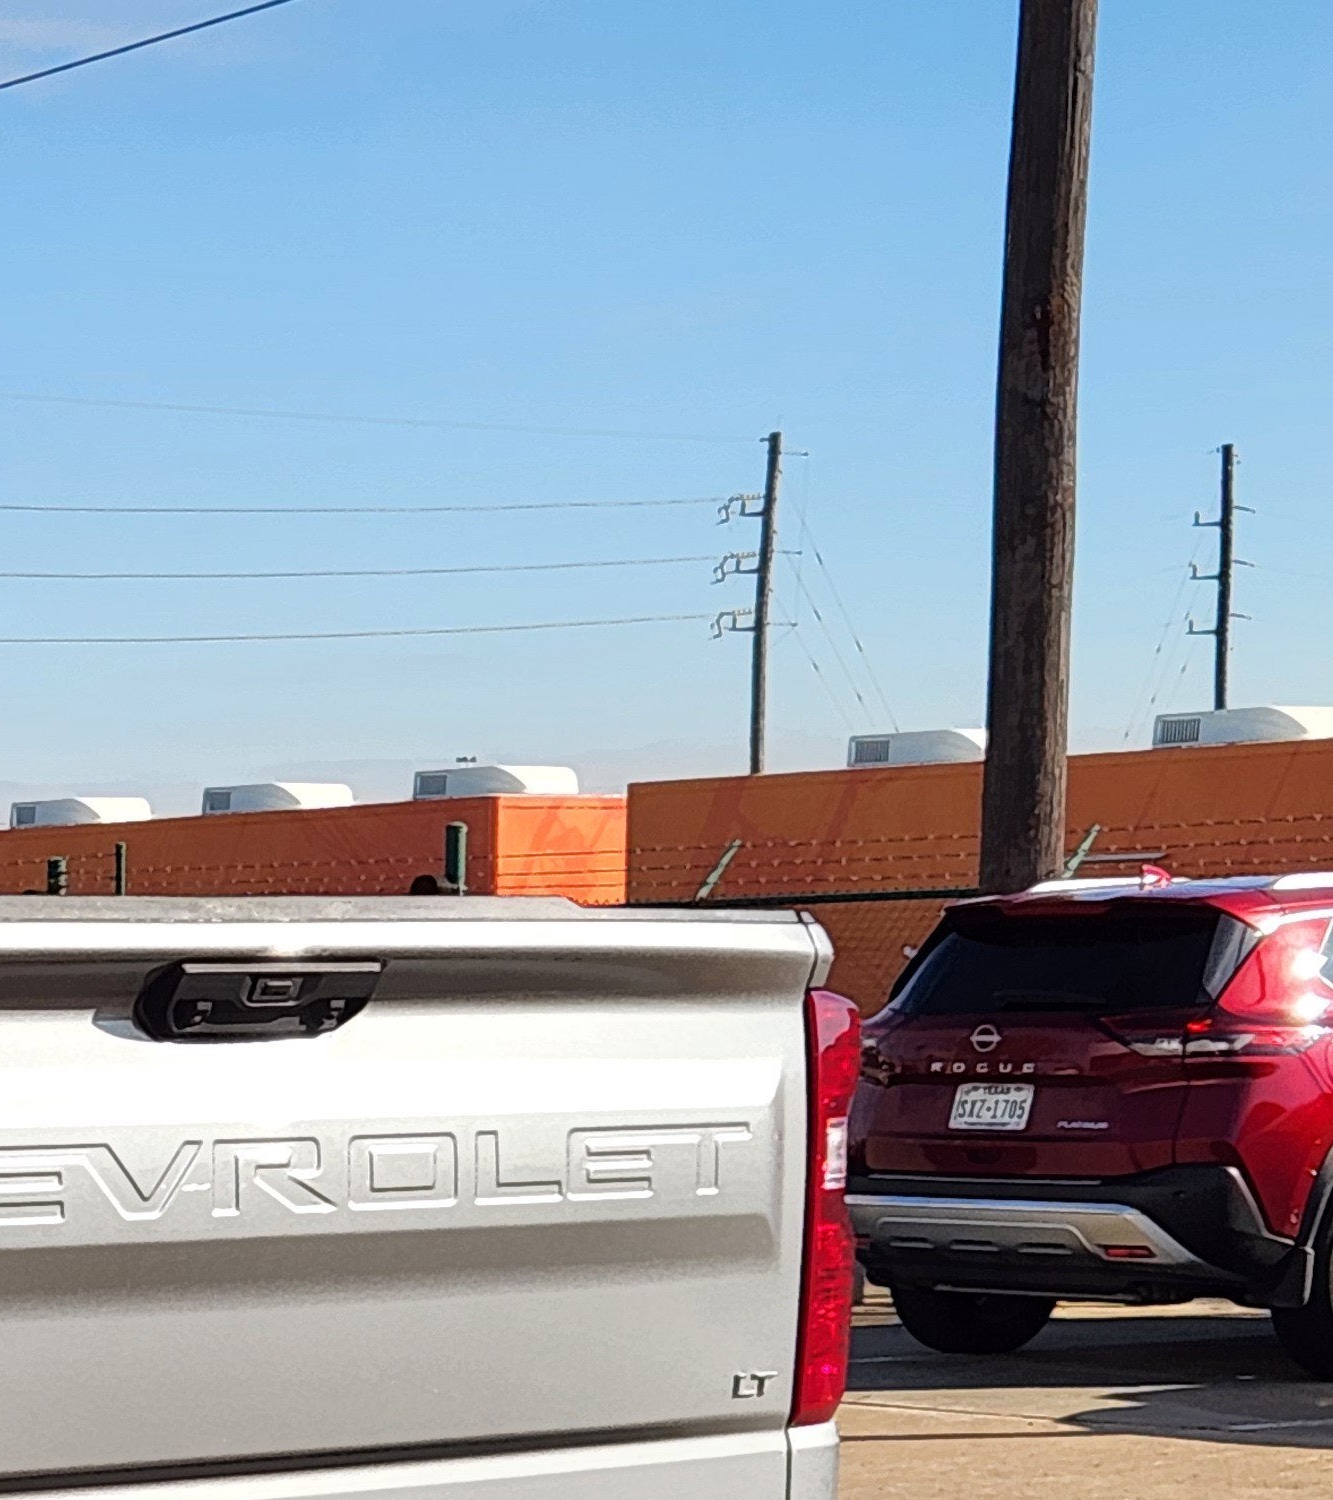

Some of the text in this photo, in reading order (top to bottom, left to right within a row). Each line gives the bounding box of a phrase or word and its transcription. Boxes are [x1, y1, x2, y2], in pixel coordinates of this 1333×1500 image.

[930, 1061, 1036, 1074] ROGUE
[983, 1085, 1012, 1096] TEXAS
[731, 1370, 778, 1399] LT
